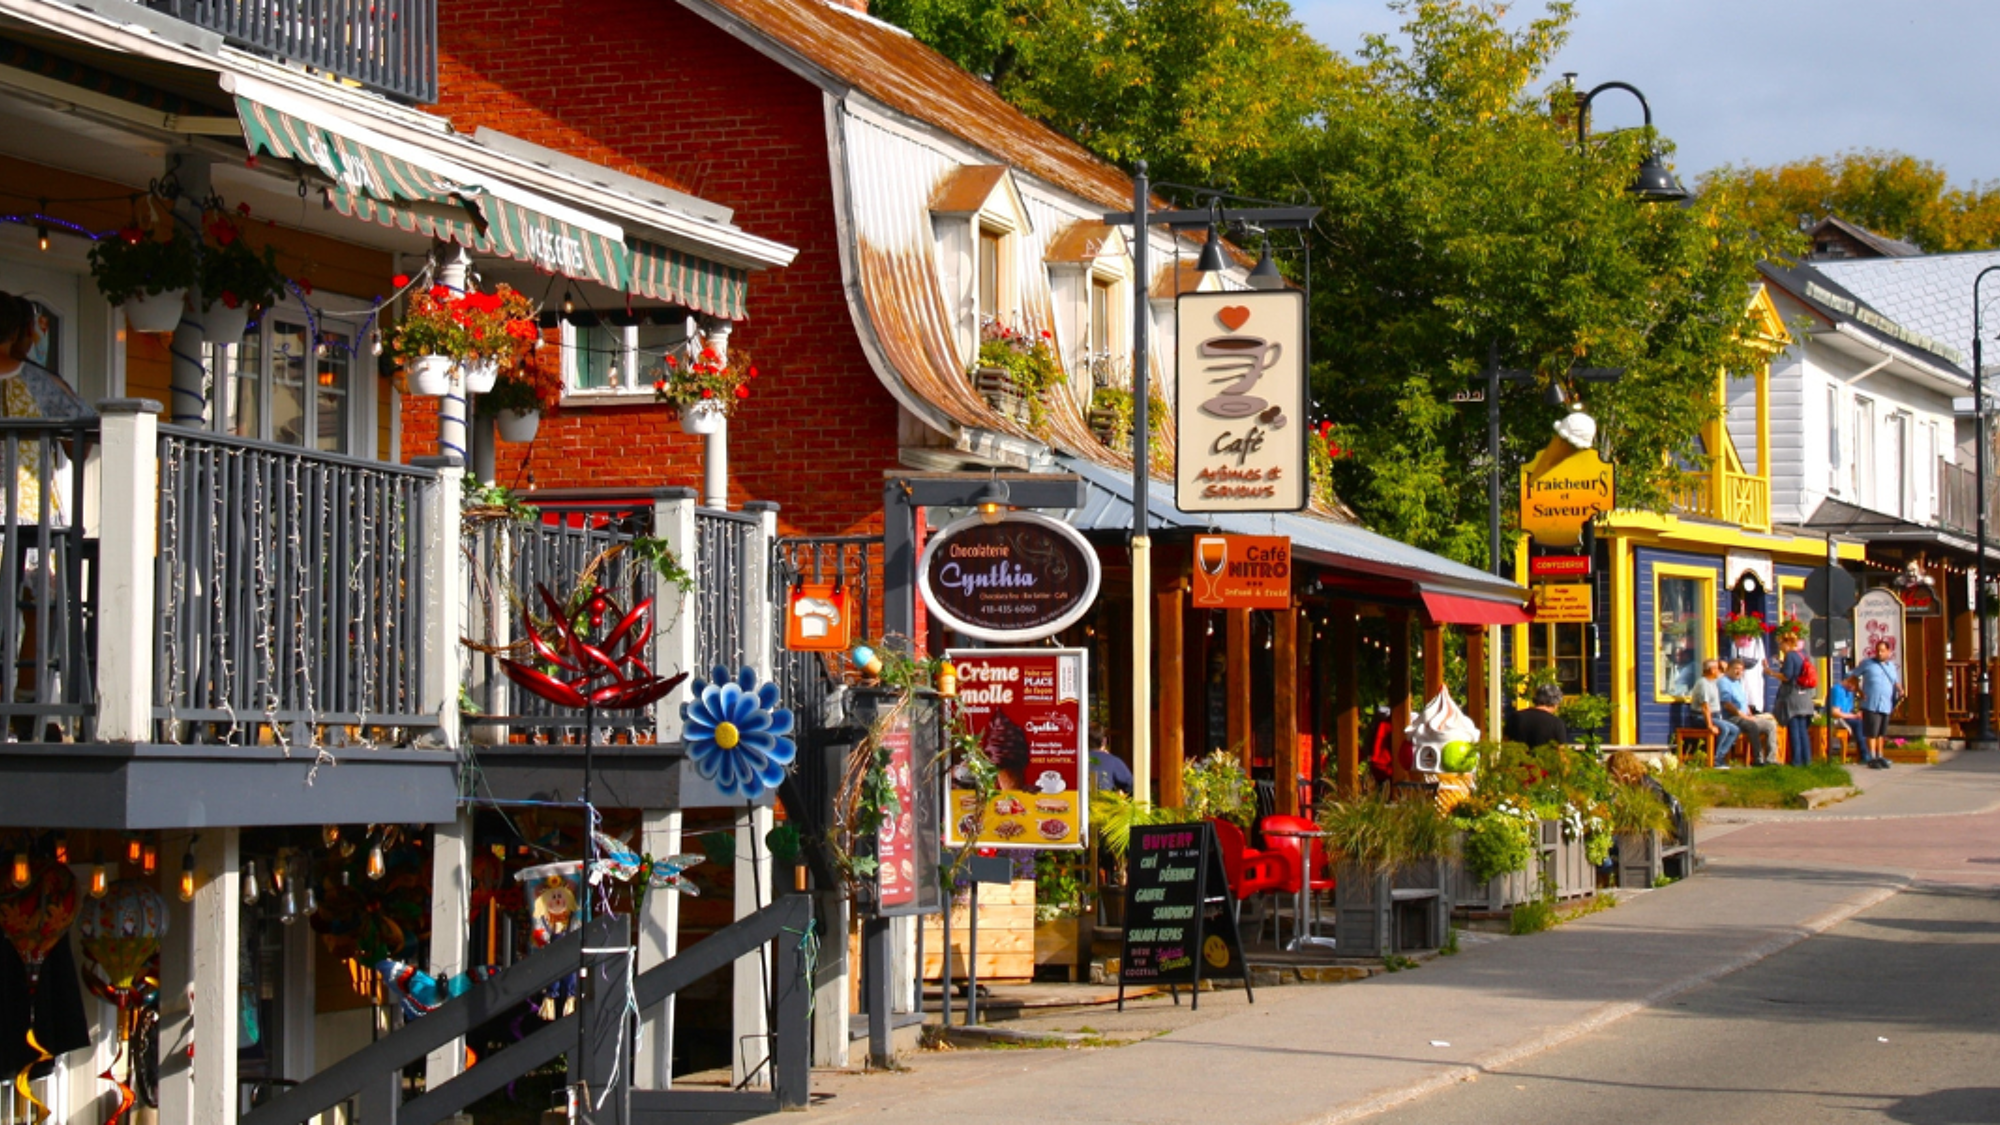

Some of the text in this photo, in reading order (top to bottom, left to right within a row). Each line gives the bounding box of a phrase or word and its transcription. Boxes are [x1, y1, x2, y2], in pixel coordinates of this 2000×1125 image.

[1210, 425, 1265, 466] Café
[949, 543, 1010, 558] Chocolaterie
[1246, 546, 1286, 562] Café
[1228, 561, 1288, 578] NITRO
[1536, 561, 1585, 570] CONFISERIE
[940, 560, 1039, 597] Cynthia
[956, 660, 1020, 682] Crème
[1023, 677, 1054, 687] PLACE
[959, 683, 1015, 705] molle
[1142, 832, 1194, 849] OUVERT
[1152, 905, 1195, 920] SANDWICH
[1128, 928, 1184, 942] SALADE REPAS
